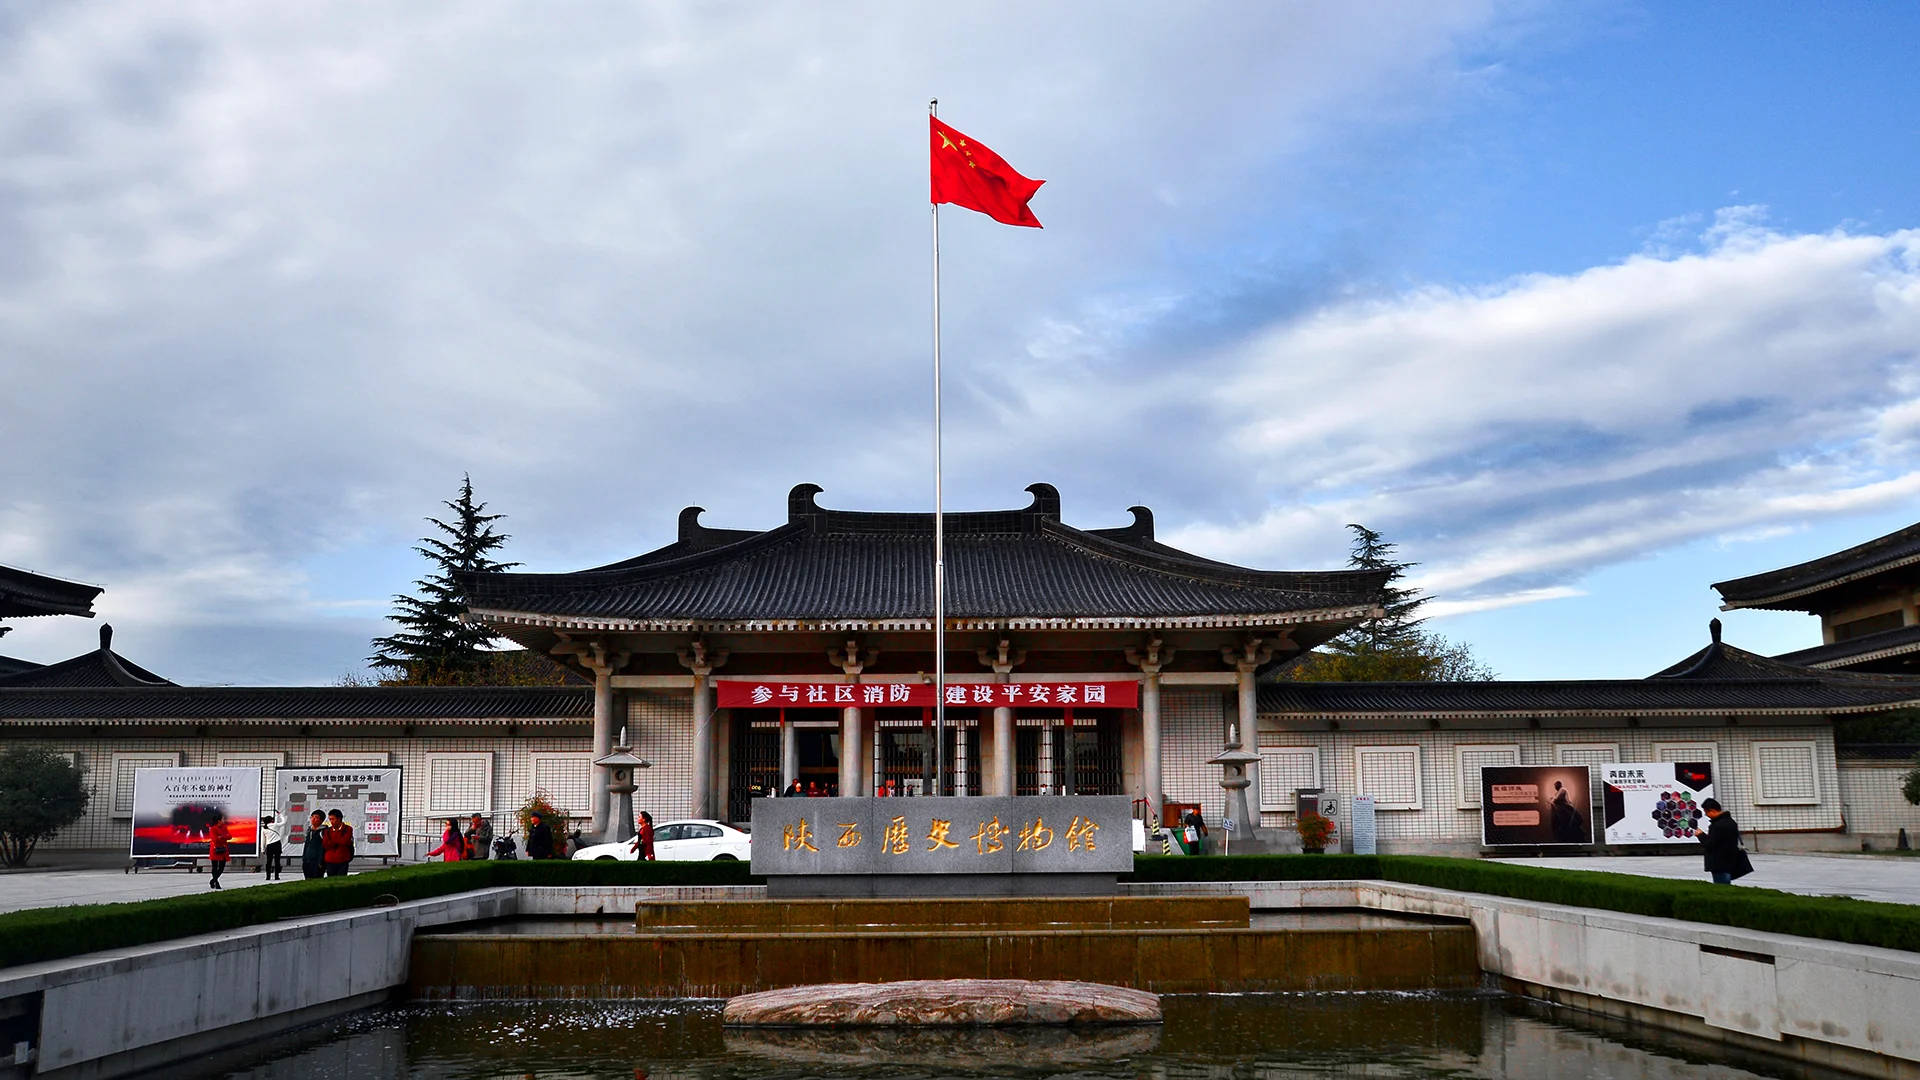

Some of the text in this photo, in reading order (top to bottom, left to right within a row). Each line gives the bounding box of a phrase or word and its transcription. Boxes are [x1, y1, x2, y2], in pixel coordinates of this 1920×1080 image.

[751, 684, 1106, 704] 参与社区消防 建设平安家园
[293, 775, 382, 783] 陕西历史博物馆展览分布图
[164, 784, 233, 792] 八百年不熄的神灯
